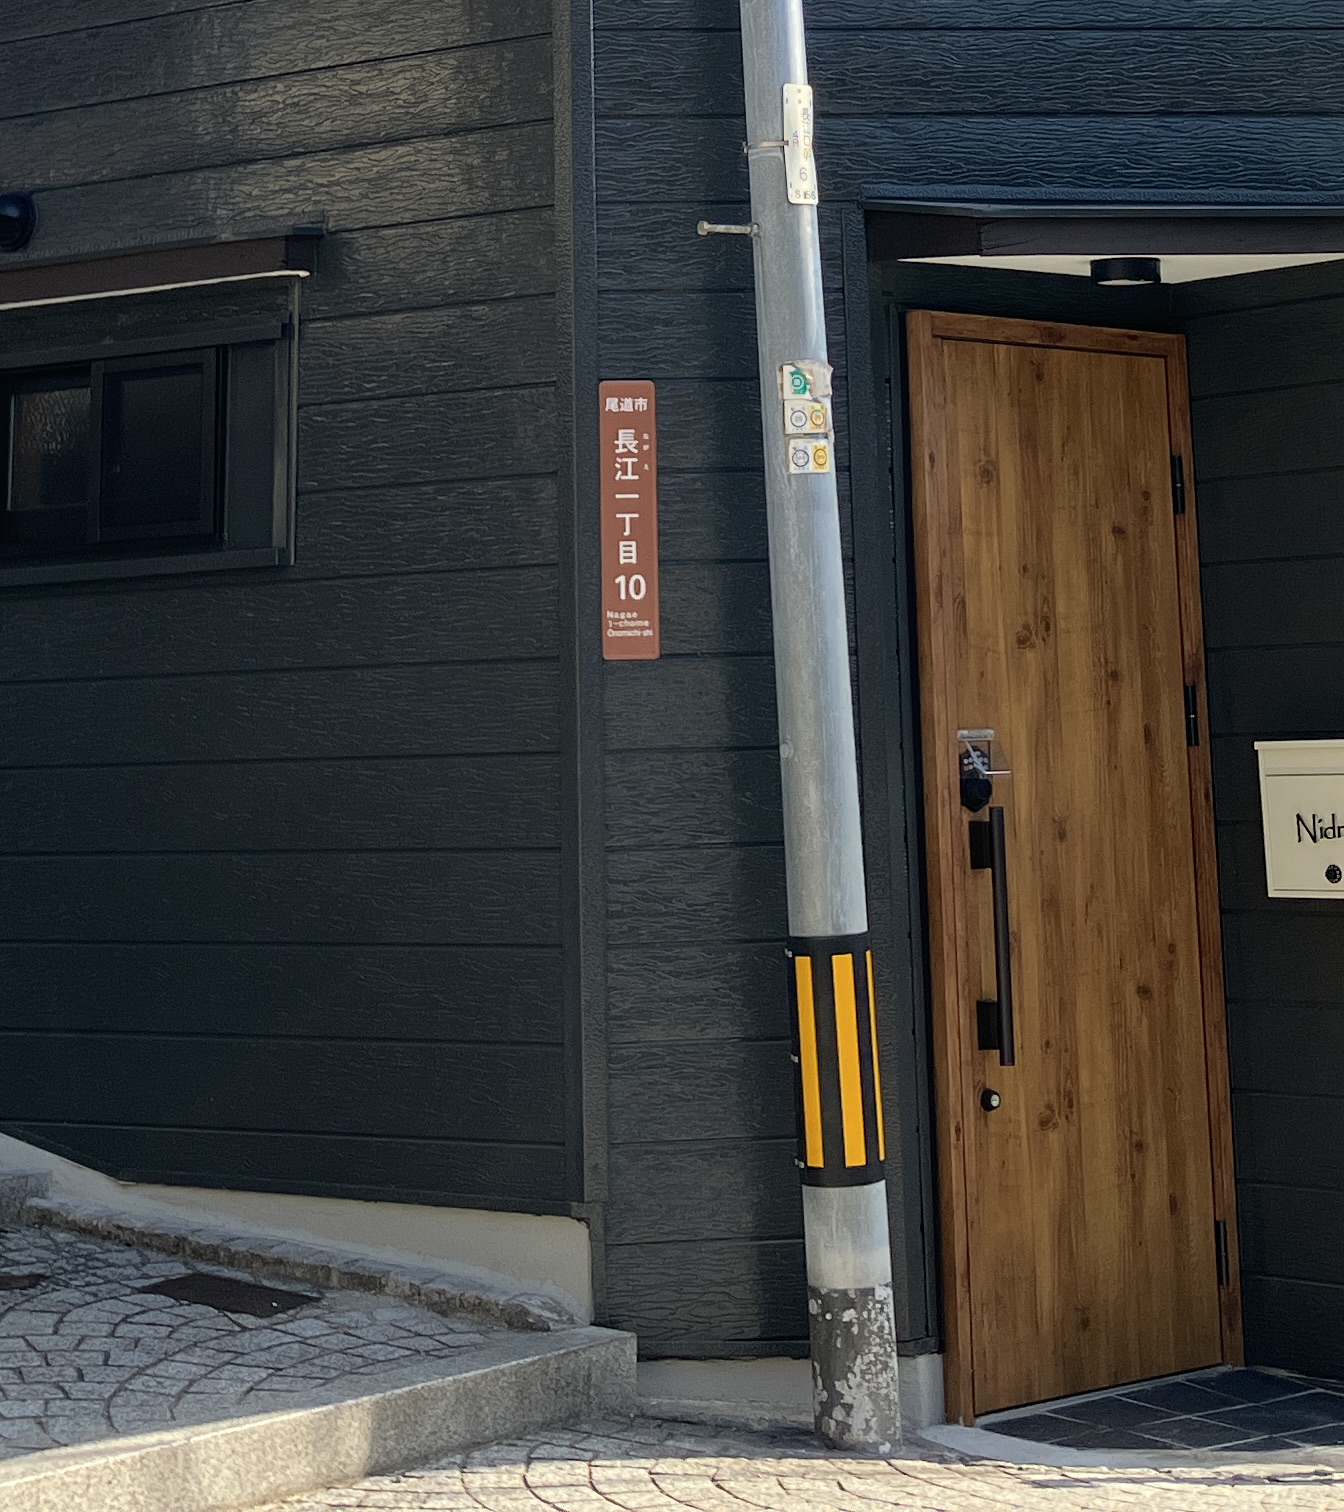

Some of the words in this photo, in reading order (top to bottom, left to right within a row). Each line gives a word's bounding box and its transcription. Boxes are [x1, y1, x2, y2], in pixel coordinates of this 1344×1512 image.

[605, 397, 648, 413] 尾道市
[614, 574, 647, 601] 10
[606, 610, 638, 619] Nagae
